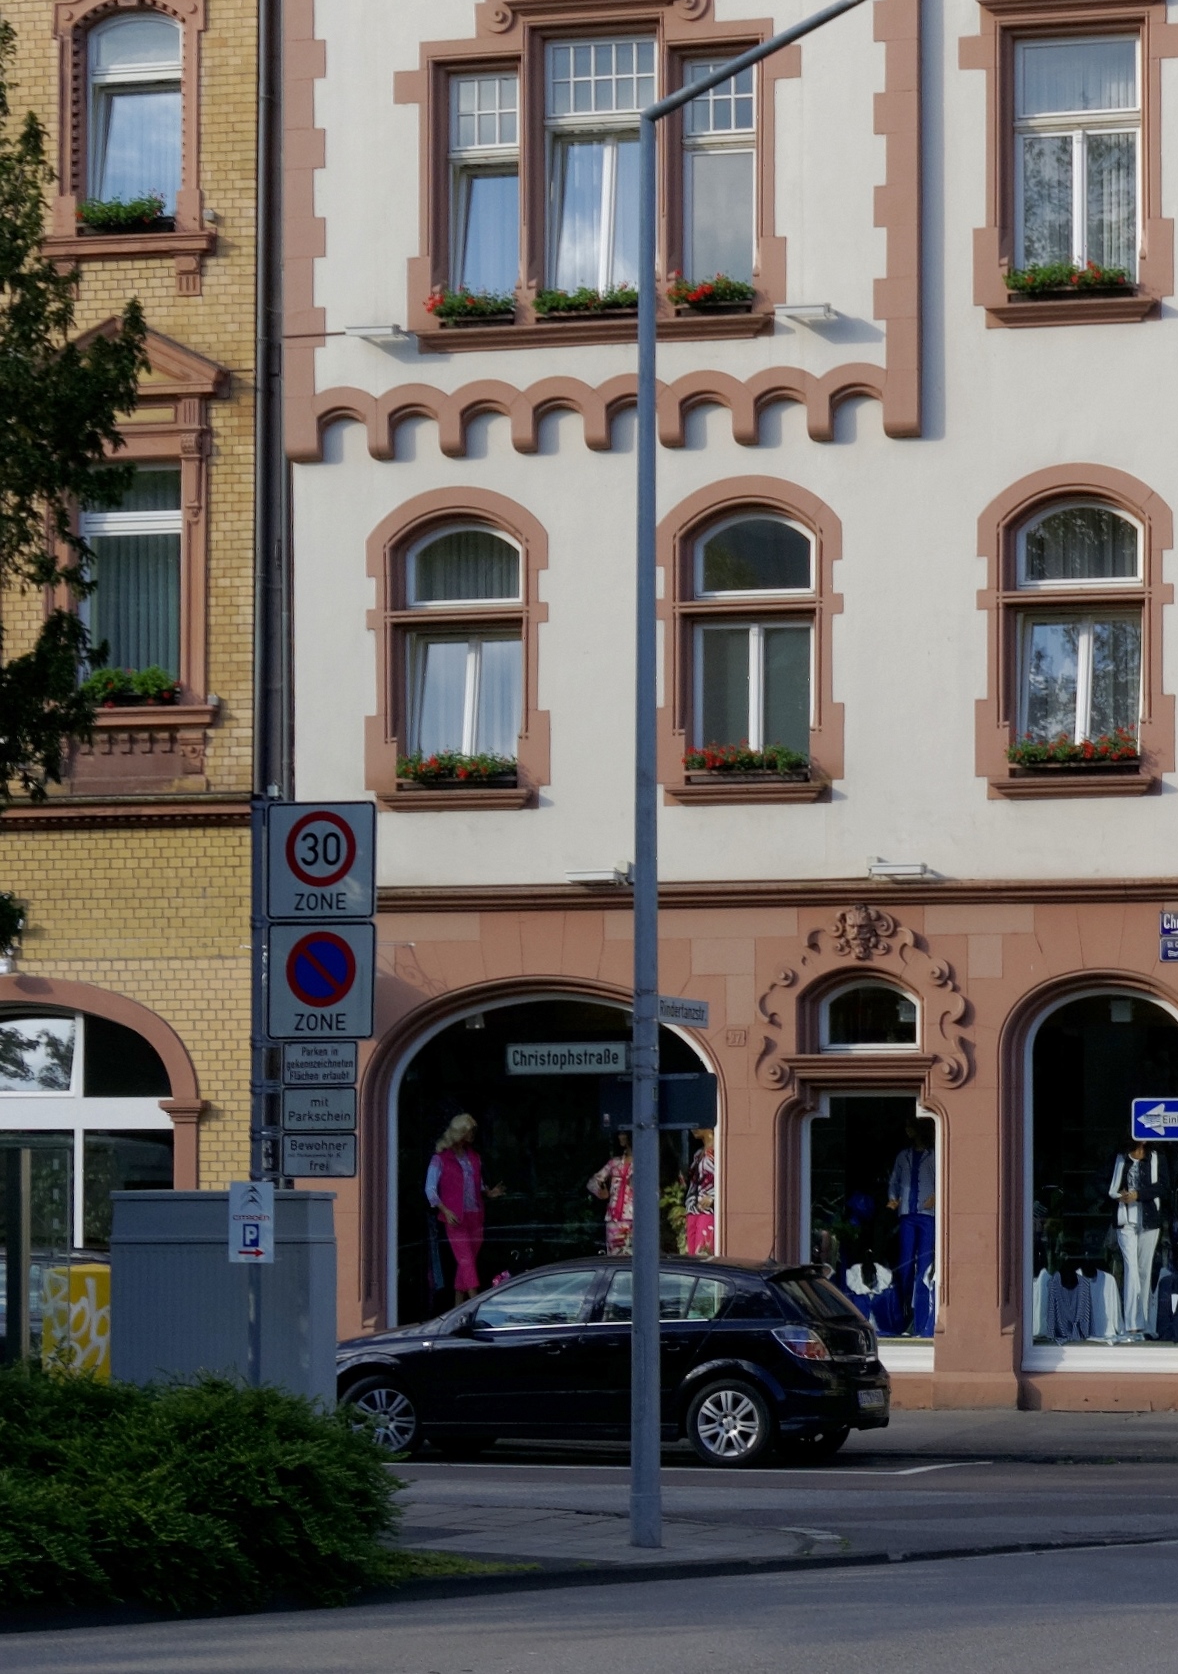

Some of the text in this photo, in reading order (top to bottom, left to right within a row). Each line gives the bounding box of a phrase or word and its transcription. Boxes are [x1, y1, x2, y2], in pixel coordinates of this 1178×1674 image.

[301, 832, 341, 866] 30
[294, 893, 347, 911] ZONE
[659, 1000, 707, 1022] Rindertanzstr.
[294, 1013, 346, 1031] ZONE
[301, 1047, 338, 1056] Parken in
[513, 1048, 619, 1070] Christophstraße
[311, 1098, 329, 1107] mit
[288, 1111, 351, 1122] Parkschein
[290, 1139, 348, 1151] Bewohner
[309, 1159, 330, 1171] frei
